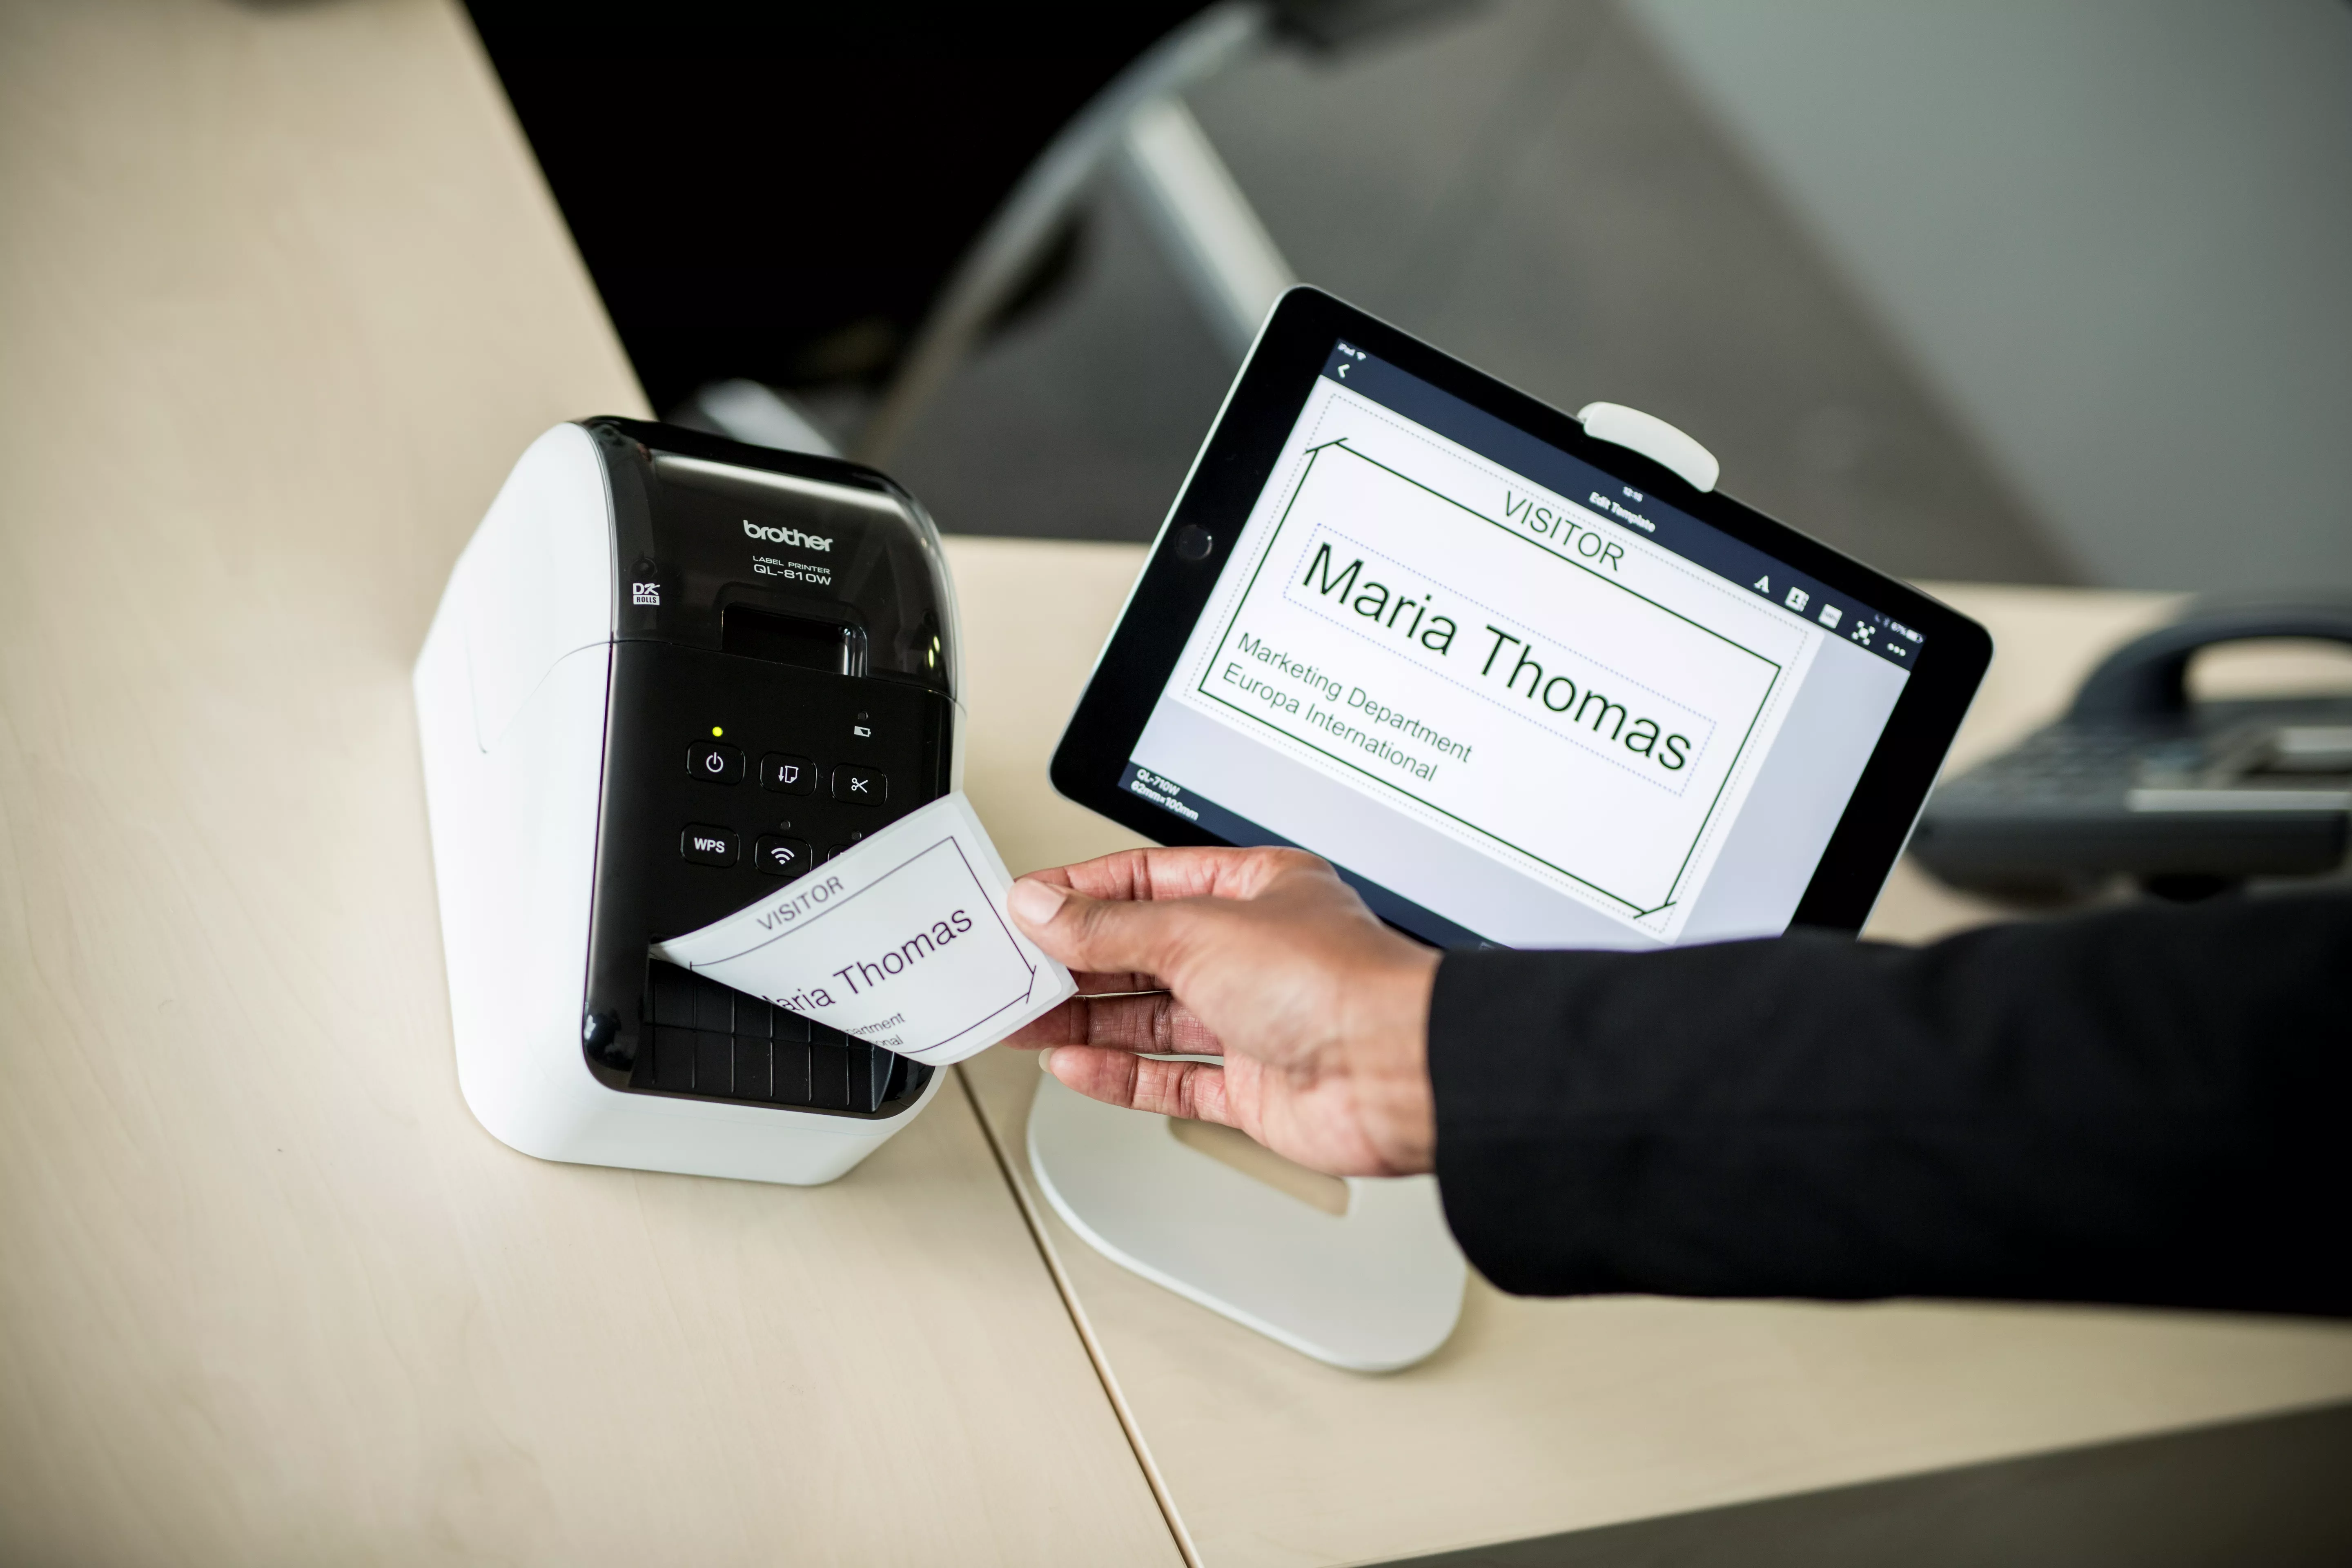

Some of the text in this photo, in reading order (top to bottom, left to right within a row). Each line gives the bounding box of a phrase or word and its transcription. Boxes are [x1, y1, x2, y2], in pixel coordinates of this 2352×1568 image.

[1505, 490, 1625, 572] VISITOR
[1589, 491, 1656, 532] Edit Template
[743, 519, 833, 552] brother
[753, 555, 831, 575] LABEL PRINTER
[754, 564, 832, 585] QL-810W
[633, 583, 661, 596] DK
[1302, 541, 1691, 771] Maria Thomas
[1237, 632, 1472, 763] Marketing Department
[1223, 662, 1438, 782] Europa International
[1137, 768, 1180, 796] QL-710W
[694, 837, 725, 853] WPS
[757, 876, 844, 930] VISITOR
[762, 909, 972, 1011] aria Thomas
